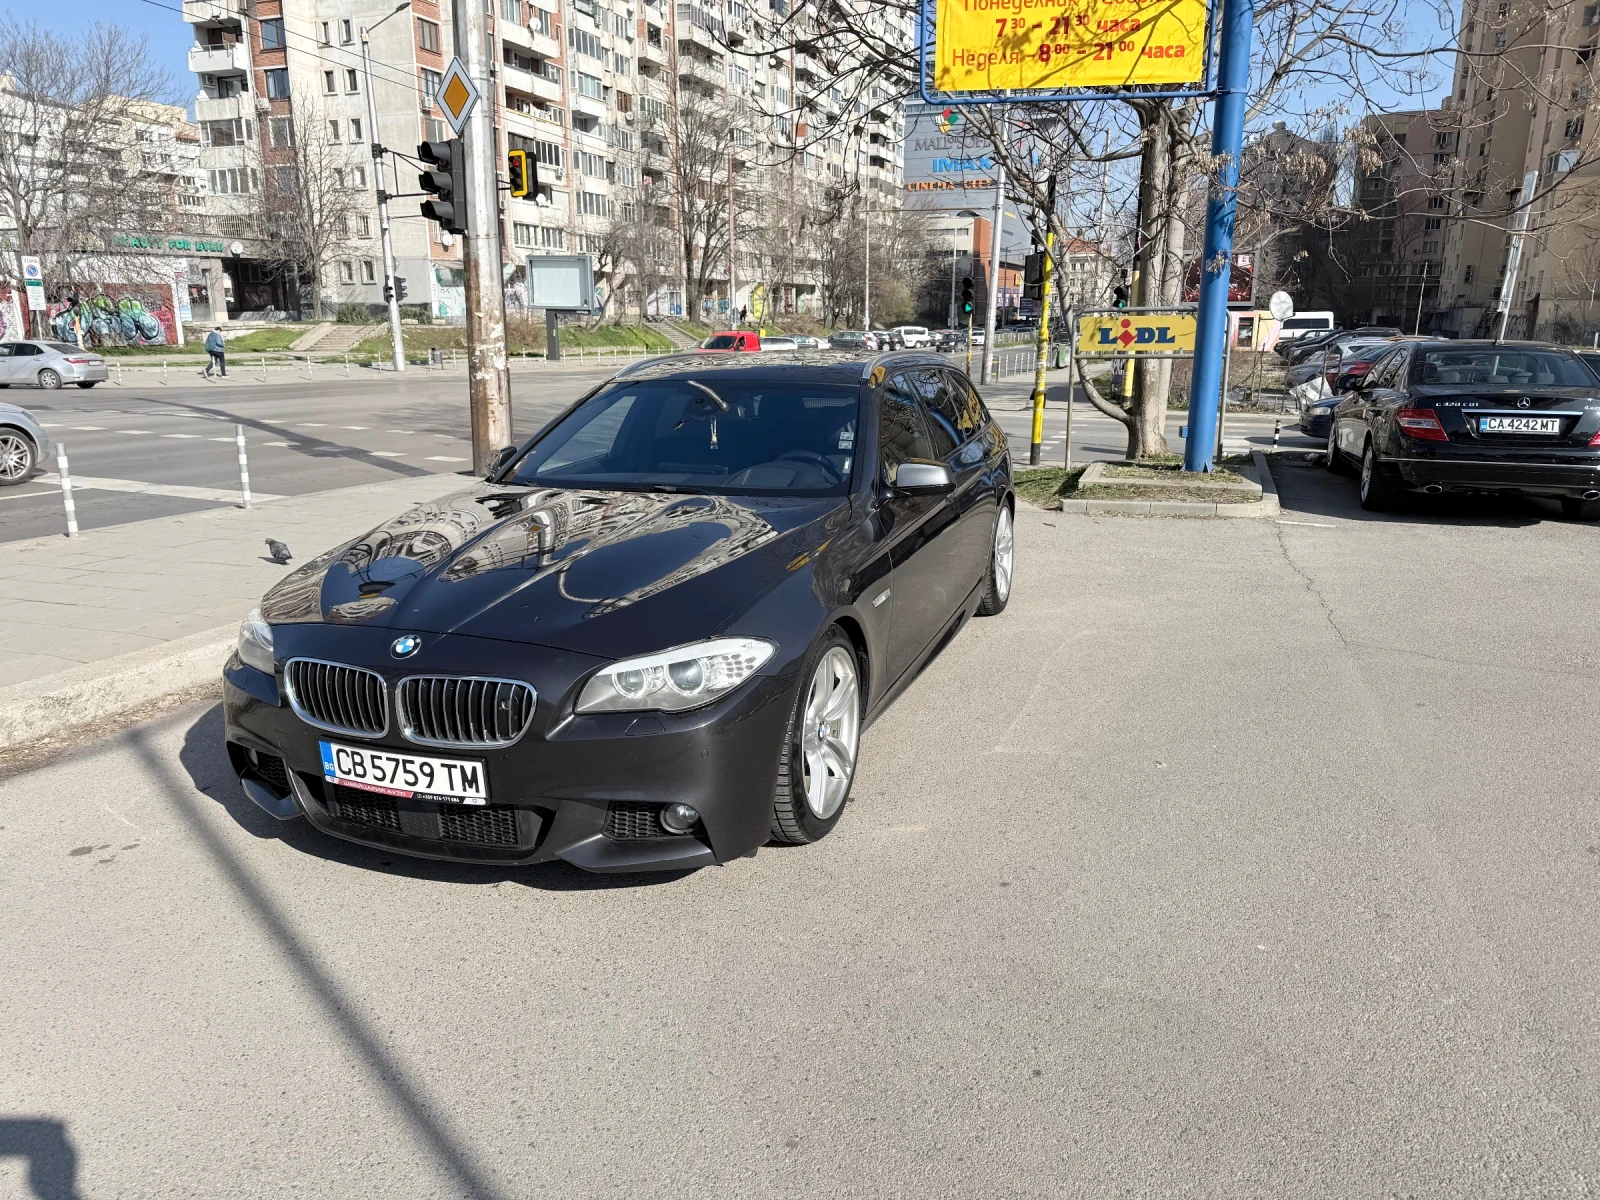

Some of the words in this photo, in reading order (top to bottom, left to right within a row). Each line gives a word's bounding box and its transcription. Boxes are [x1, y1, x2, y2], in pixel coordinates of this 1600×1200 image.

[1096, 18, 1141, 33] часа
[951, 48, 1019, 71] Неделя
[1141, 43, 1186, 60] часа
[932, 156, 994, 173] IMAX
[907, 181, 956, 191] CINEMA
[168, 239, 192, 251] FOR
